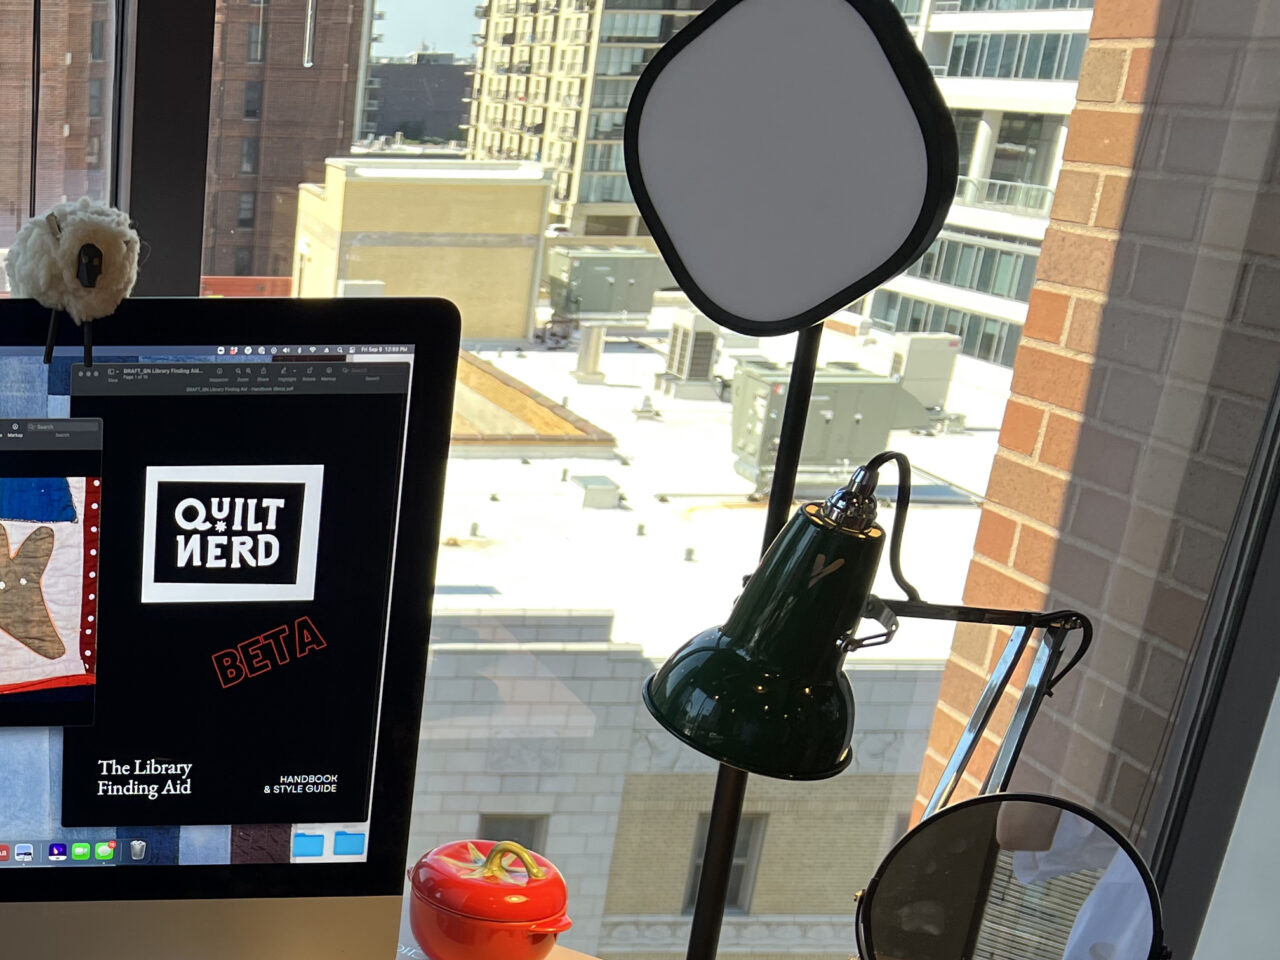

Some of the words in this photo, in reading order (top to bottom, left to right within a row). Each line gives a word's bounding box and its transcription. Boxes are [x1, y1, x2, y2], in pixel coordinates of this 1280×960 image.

[152, 367, 170, 376] Library
[171, 367, 190, 376] Finding
[174, 498, 285, 532] QUILT
[176, 534, 280, 568] NERD
[212, 616, 327, 688] BETA
[98, 759, 130, 776] The
[134, 758, 192, 779] Library
[280, 774, 338, 784] HANDBOOK
[97, 780, 159, 800] Finding
[161, 779, 192, 795] Aid
[264, 785, 271, 794] &
[273, 785, 303, 794] STYLE
[306, 784, 337, 794] GUIDE
